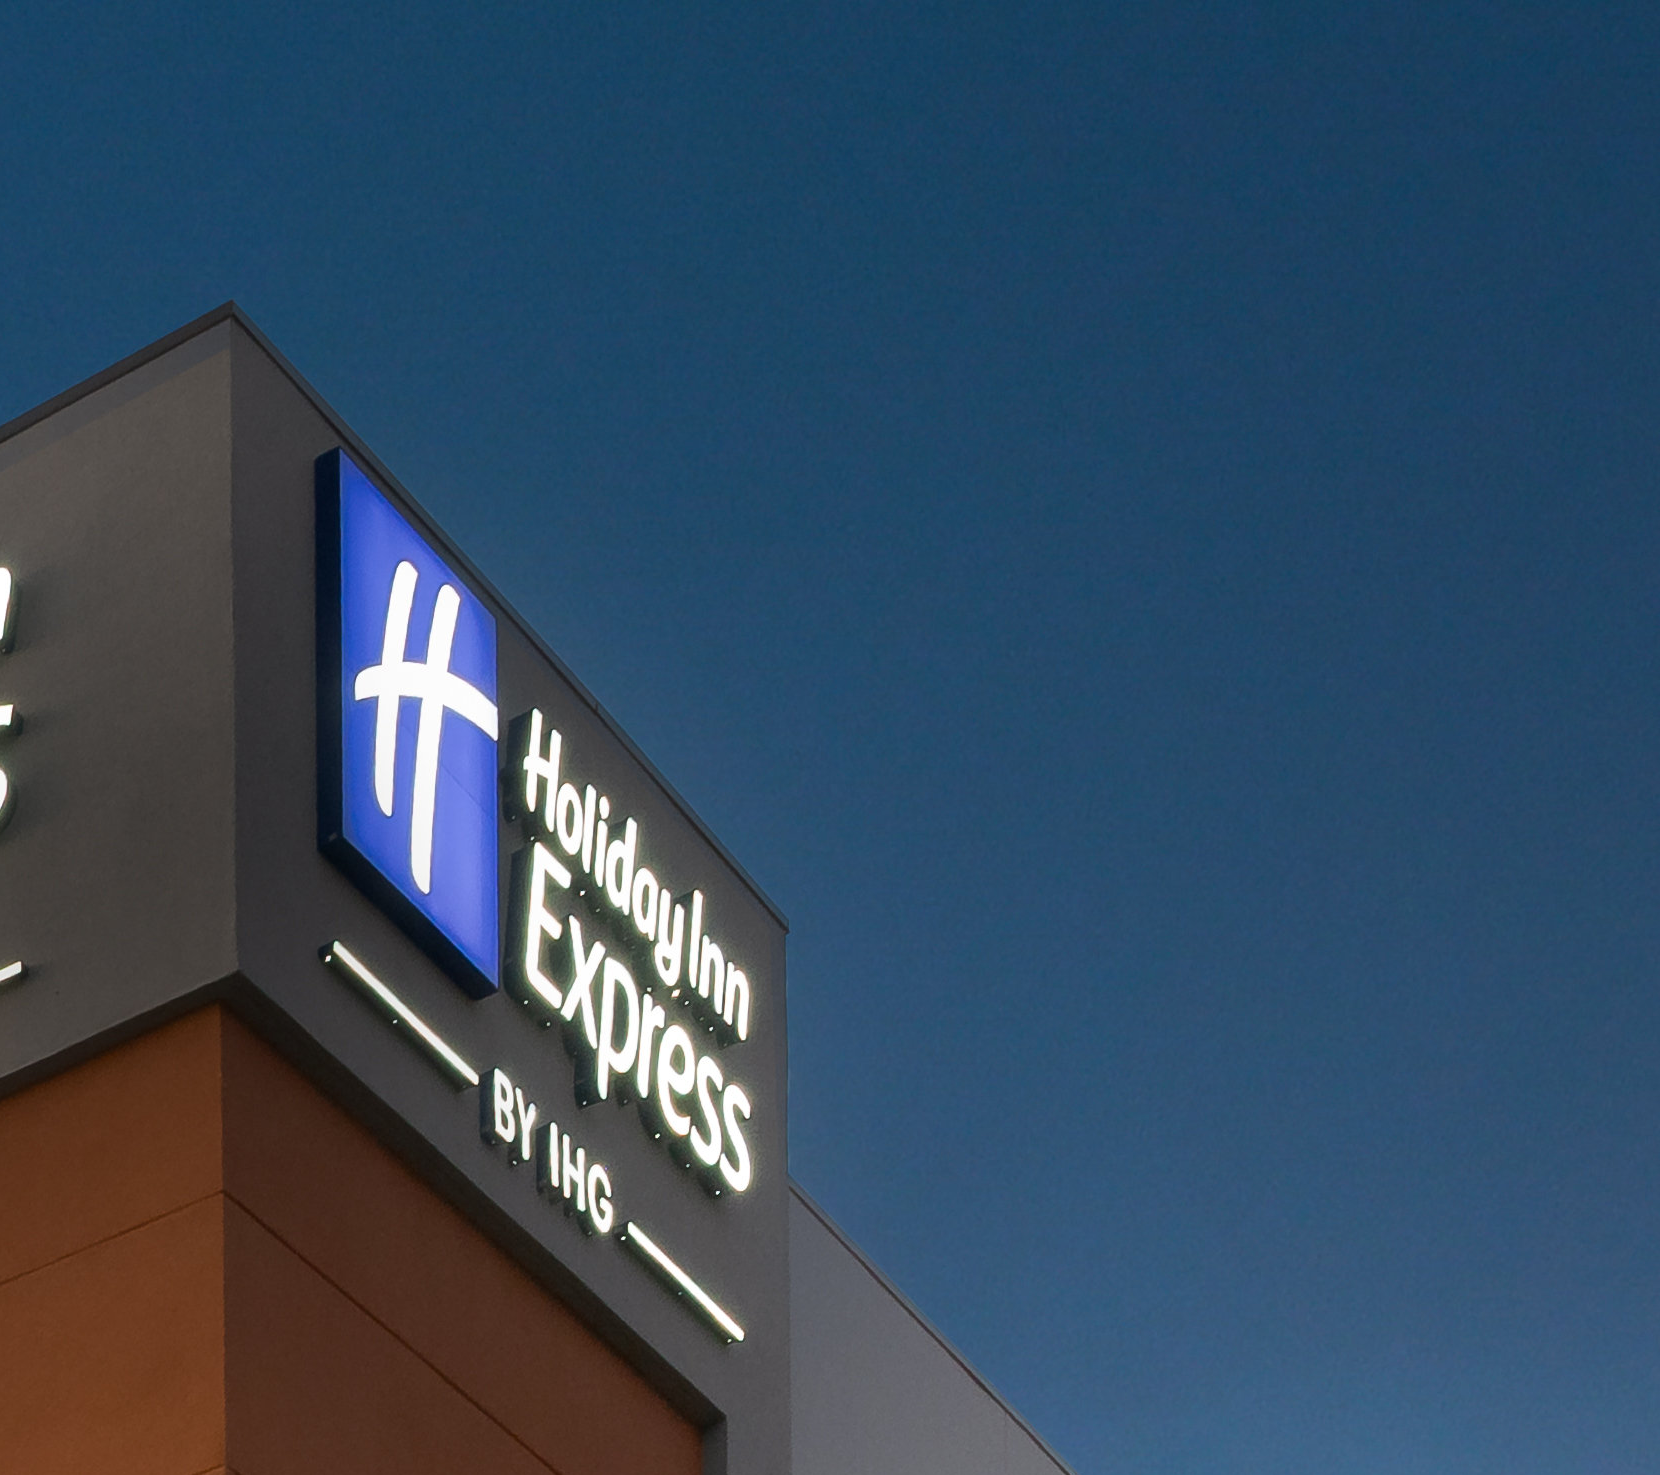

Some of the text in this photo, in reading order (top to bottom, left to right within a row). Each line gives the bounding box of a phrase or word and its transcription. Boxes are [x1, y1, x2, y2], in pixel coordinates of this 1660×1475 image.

[522, 707, 751, 1042] Holiday Inn
[524, 841, 752, 1193] Express
[492, 1067, 615, 1234] BY IHG
